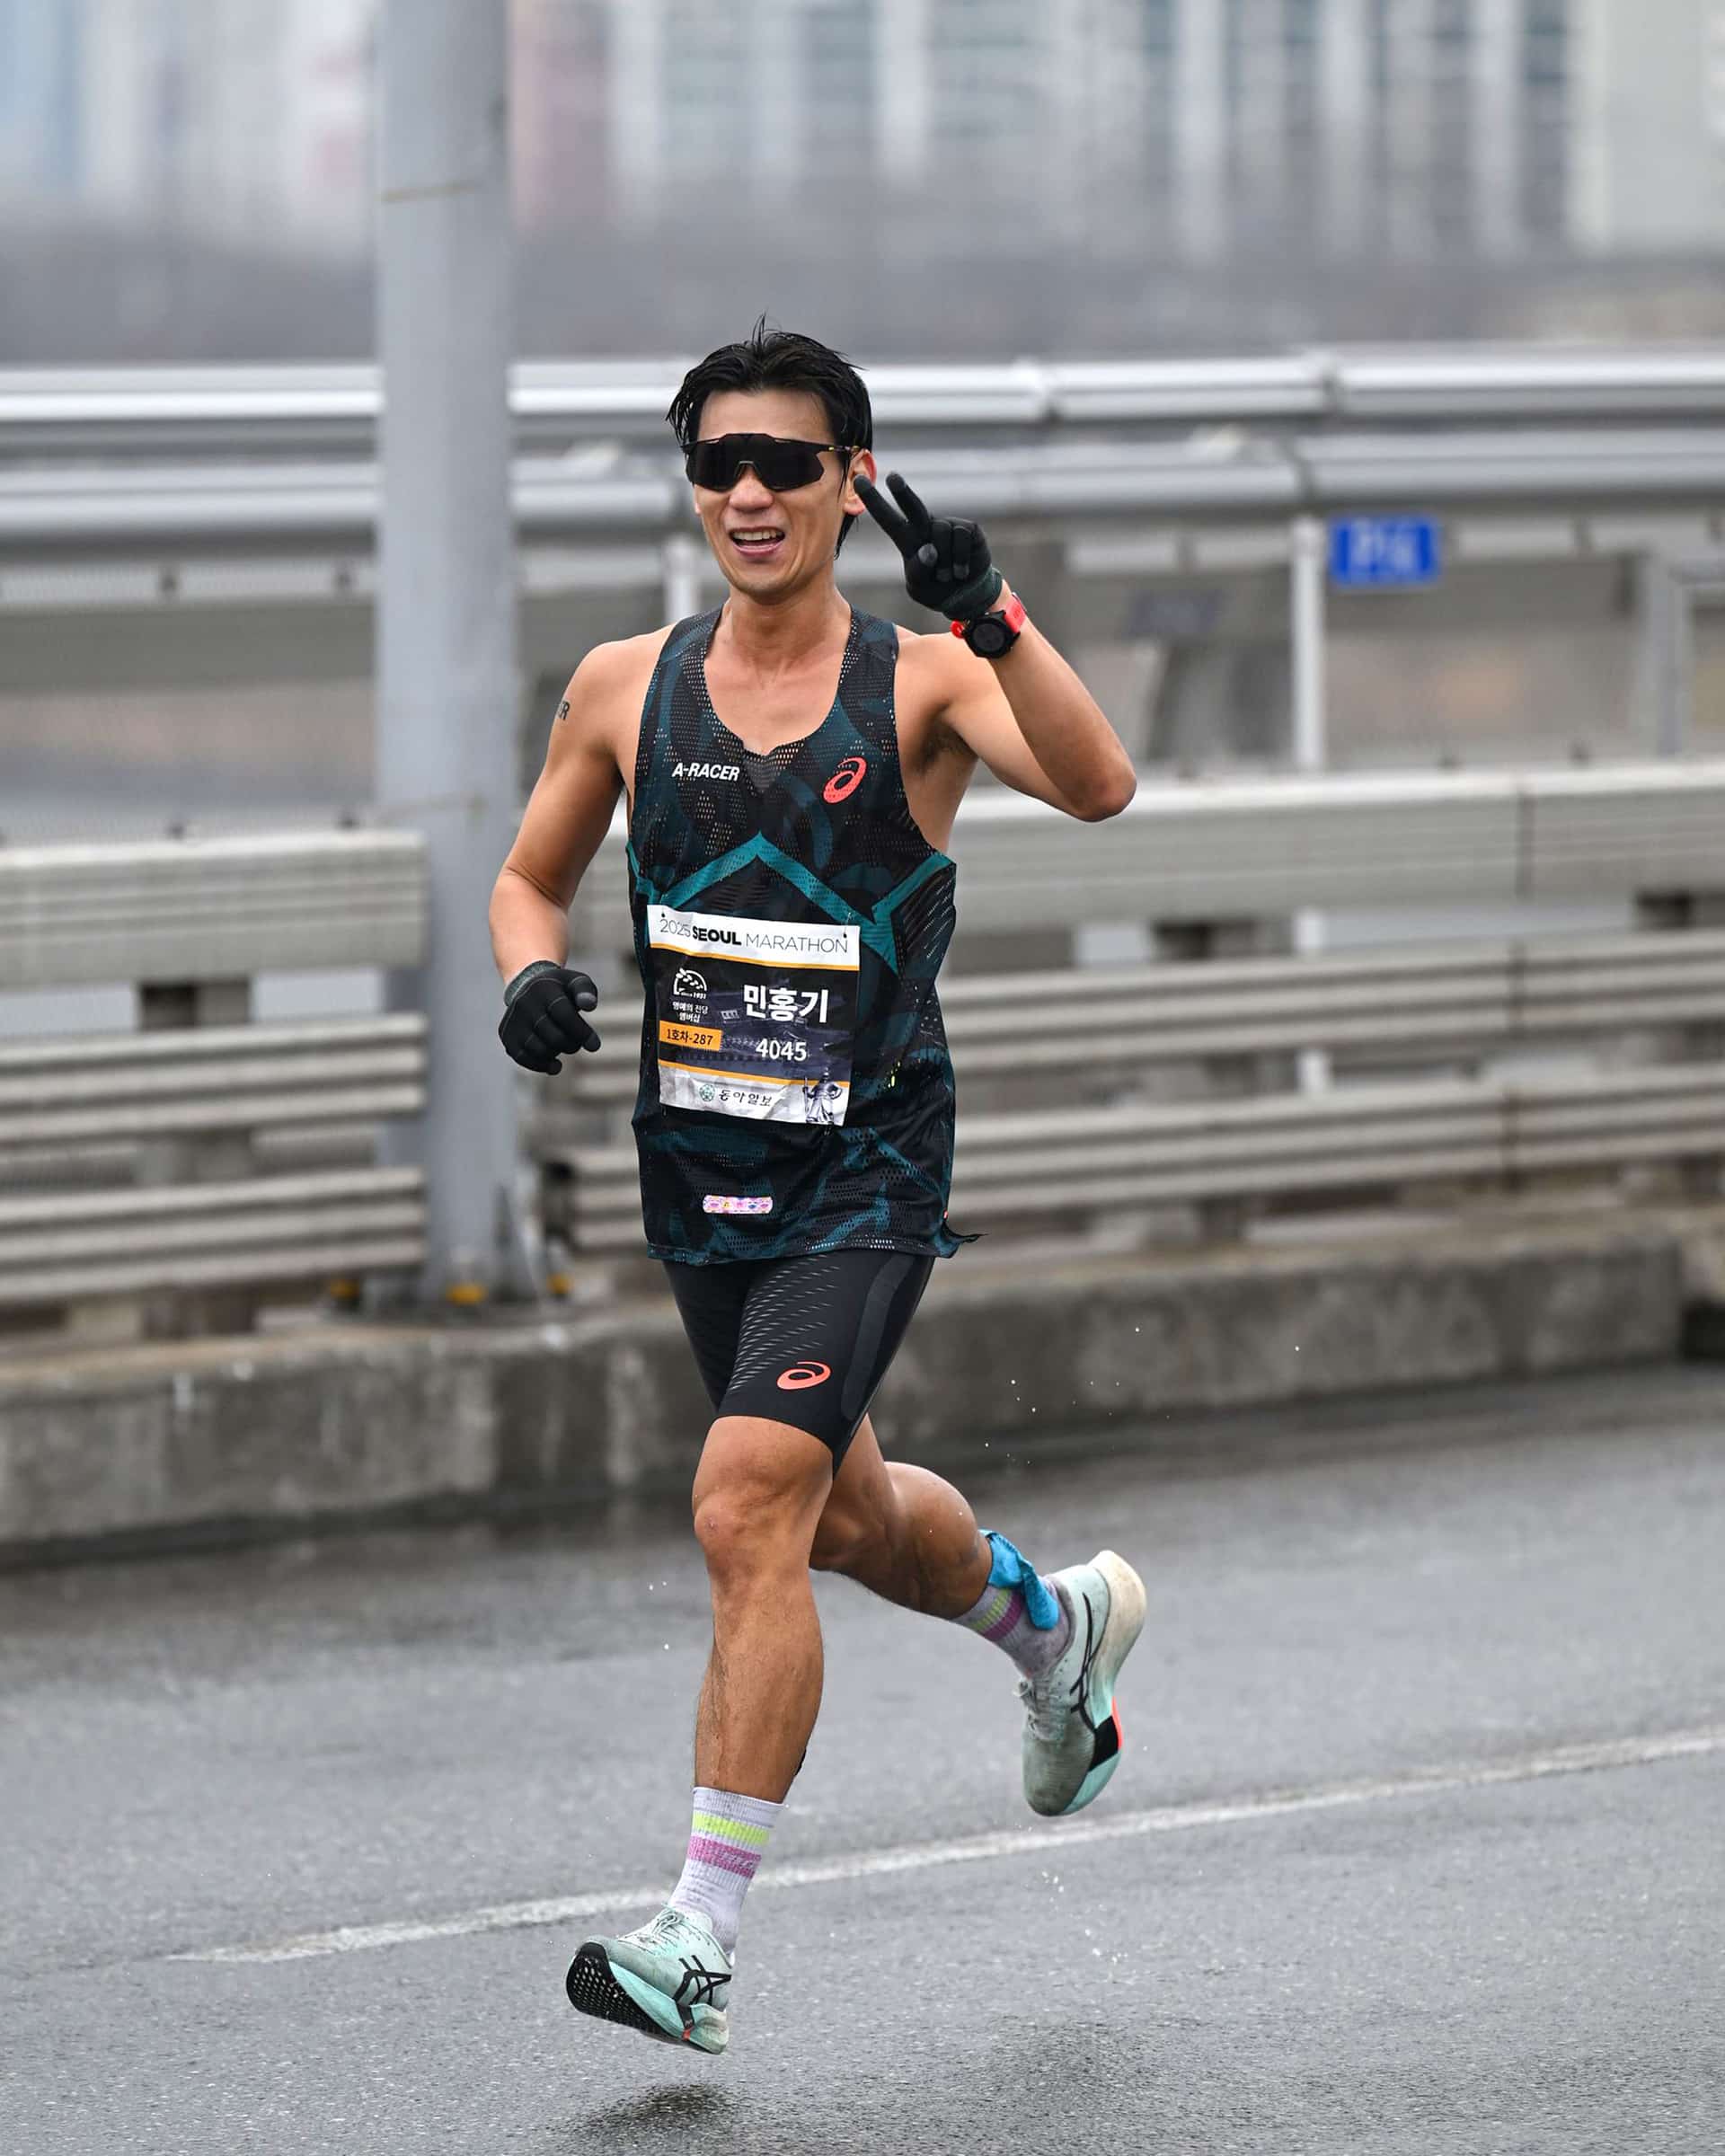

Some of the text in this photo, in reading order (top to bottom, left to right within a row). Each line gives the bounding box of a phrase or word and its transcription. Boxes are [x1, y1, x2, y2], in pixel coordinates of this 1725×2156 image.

[671, 762, 740, 782] A-RACER
[659, 919, 848, 954] 2025 SEOUL MARATHON
[694, 1004, 709, 1015] 전당
[743, 984, 829, 1023] 민홍기
[667, 1028, 713, 1046] 1호차-287
[756, 1038, 807, 1062] 4045
[718, 1089, 774, 1107] 동아일보
